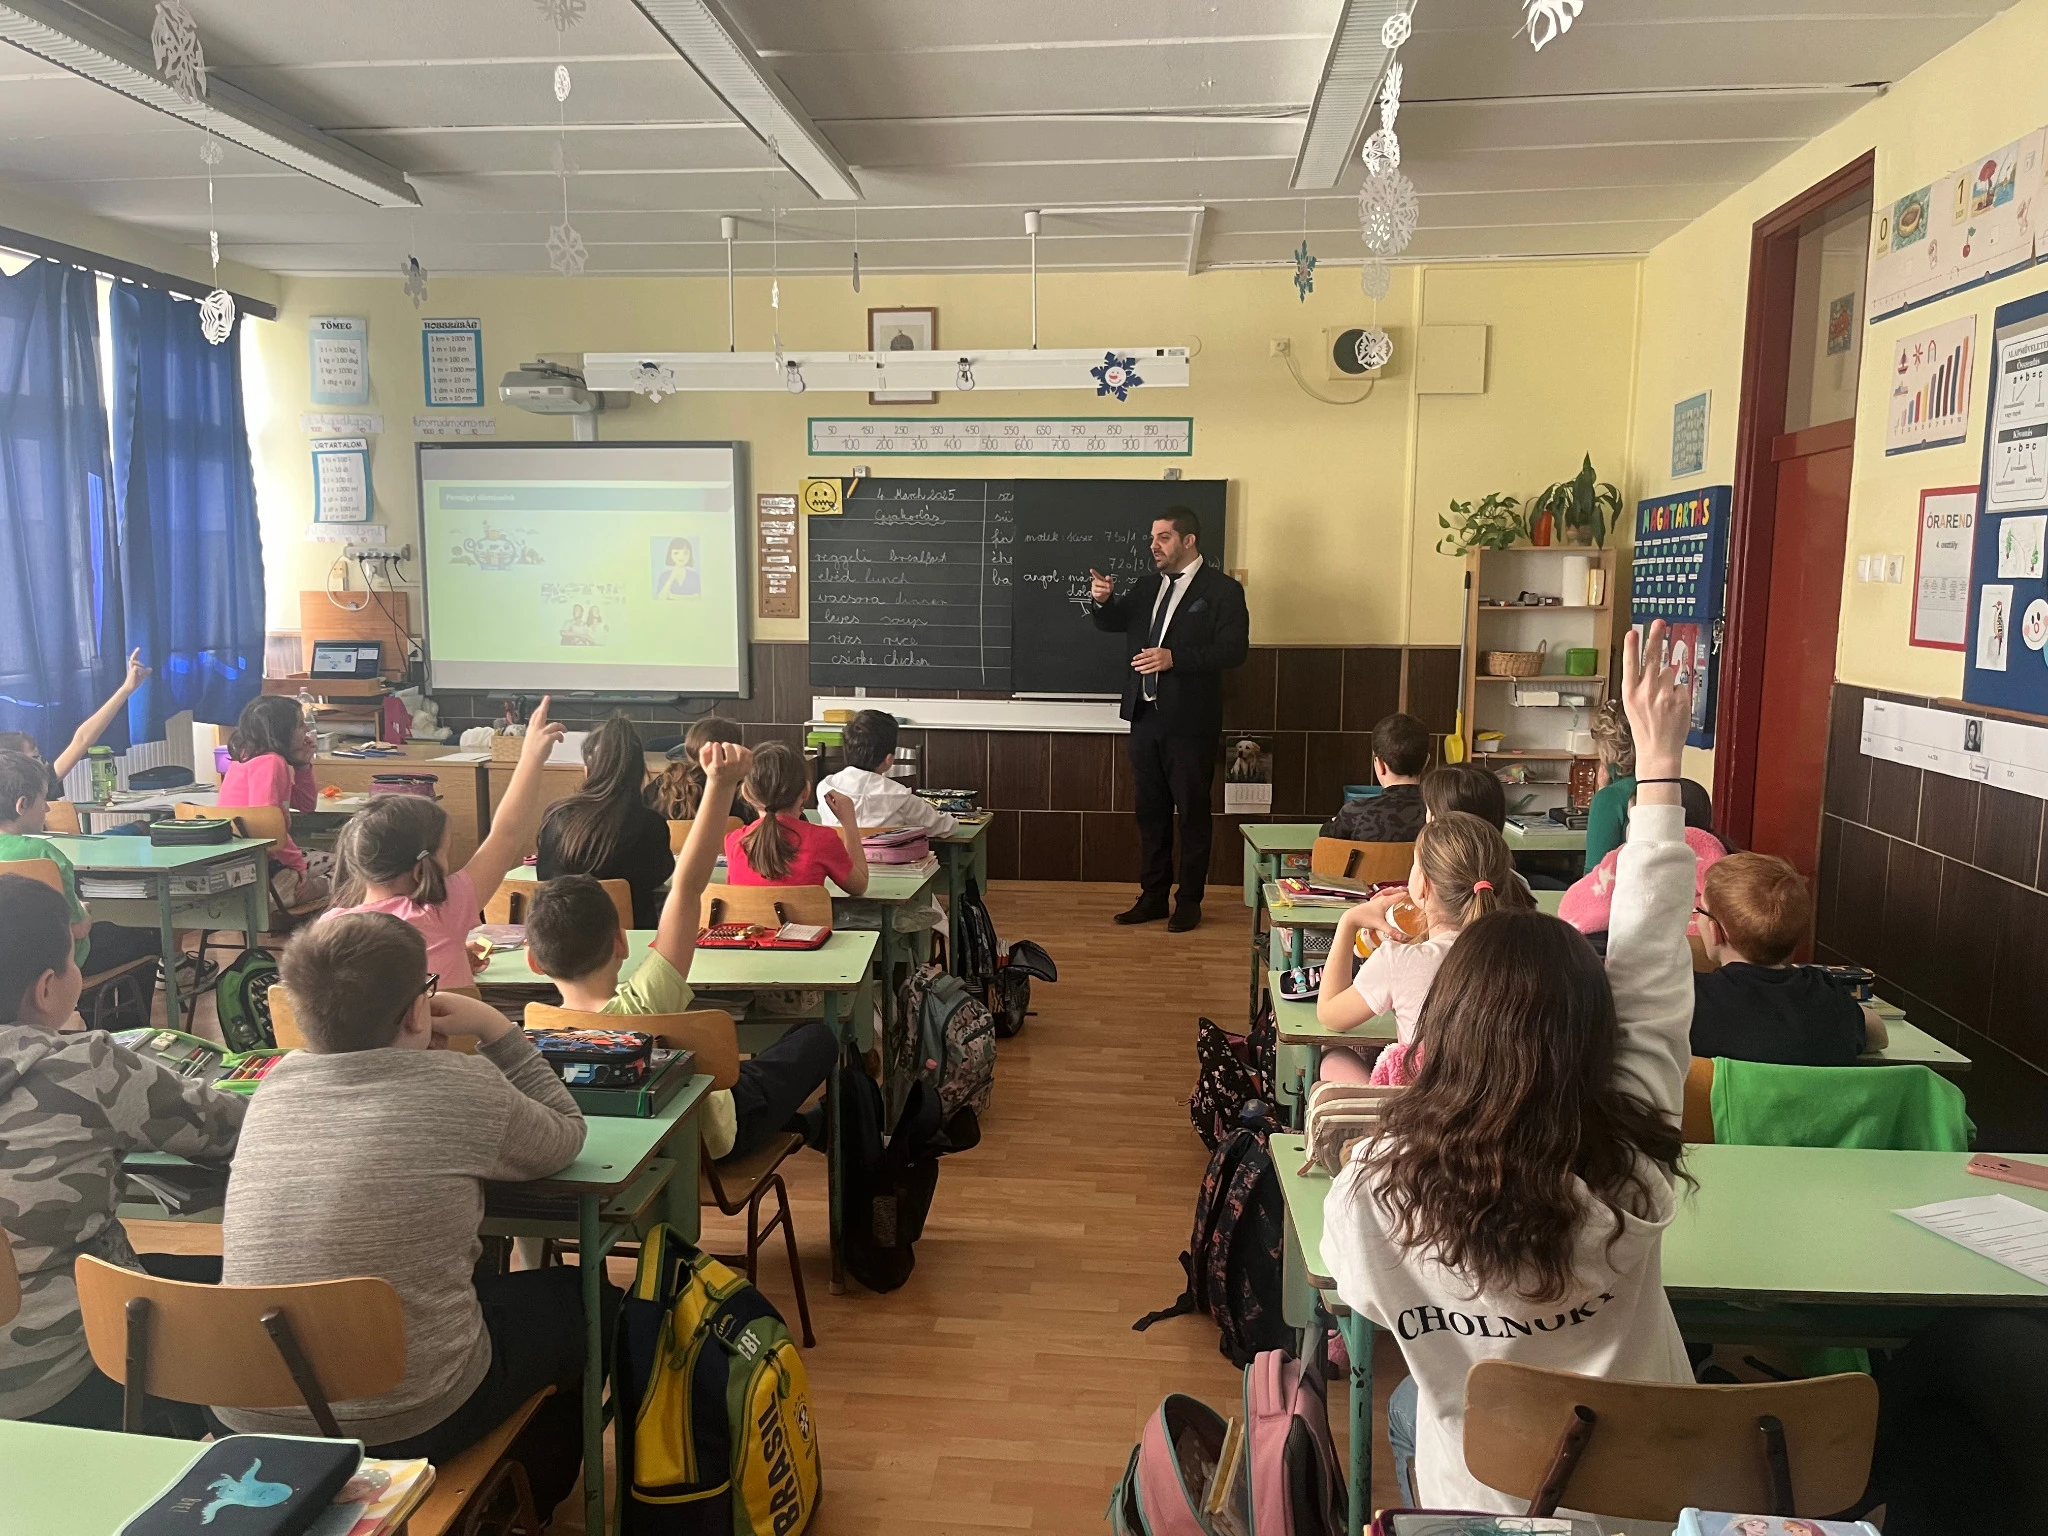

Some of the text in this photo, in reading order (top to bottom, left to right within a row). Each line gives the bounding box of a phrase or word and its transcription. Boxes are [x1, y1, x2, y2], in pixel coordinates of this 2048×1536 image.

[1956, 178, 1965, 205] 1
[1880, 217, 1888, 240] 0
[320, 320, 352, 330] TÖMEG
[828, 425, 1159, 435] 50 150 250 350 450 550 650 750 850 950
[812, 439, 1179, 450] 0 100 200 300 400 500 600 700 800 900 1000
[877, 487, 957, 500] 4 March 2025
[874, 505, 940, 525] Gyakorlás
[1642, 491, 1710, 534] MAGATARTÁS
[1926, 511, 1973, 529] ÓRAREND
[815, 548, 872, 569] reggeli
[817, 567, 911, 584] ebéd lunch
[818, 594, 886, 605] vacsora
[824, 608, 929, 628] leves soup
[828, 632, 919, 647] rizs rice
[831, 650, 875, 666] csirke
[737, 1328, 761, 1361] CBF
[758, 1391, 800, 1536] BRASIL
